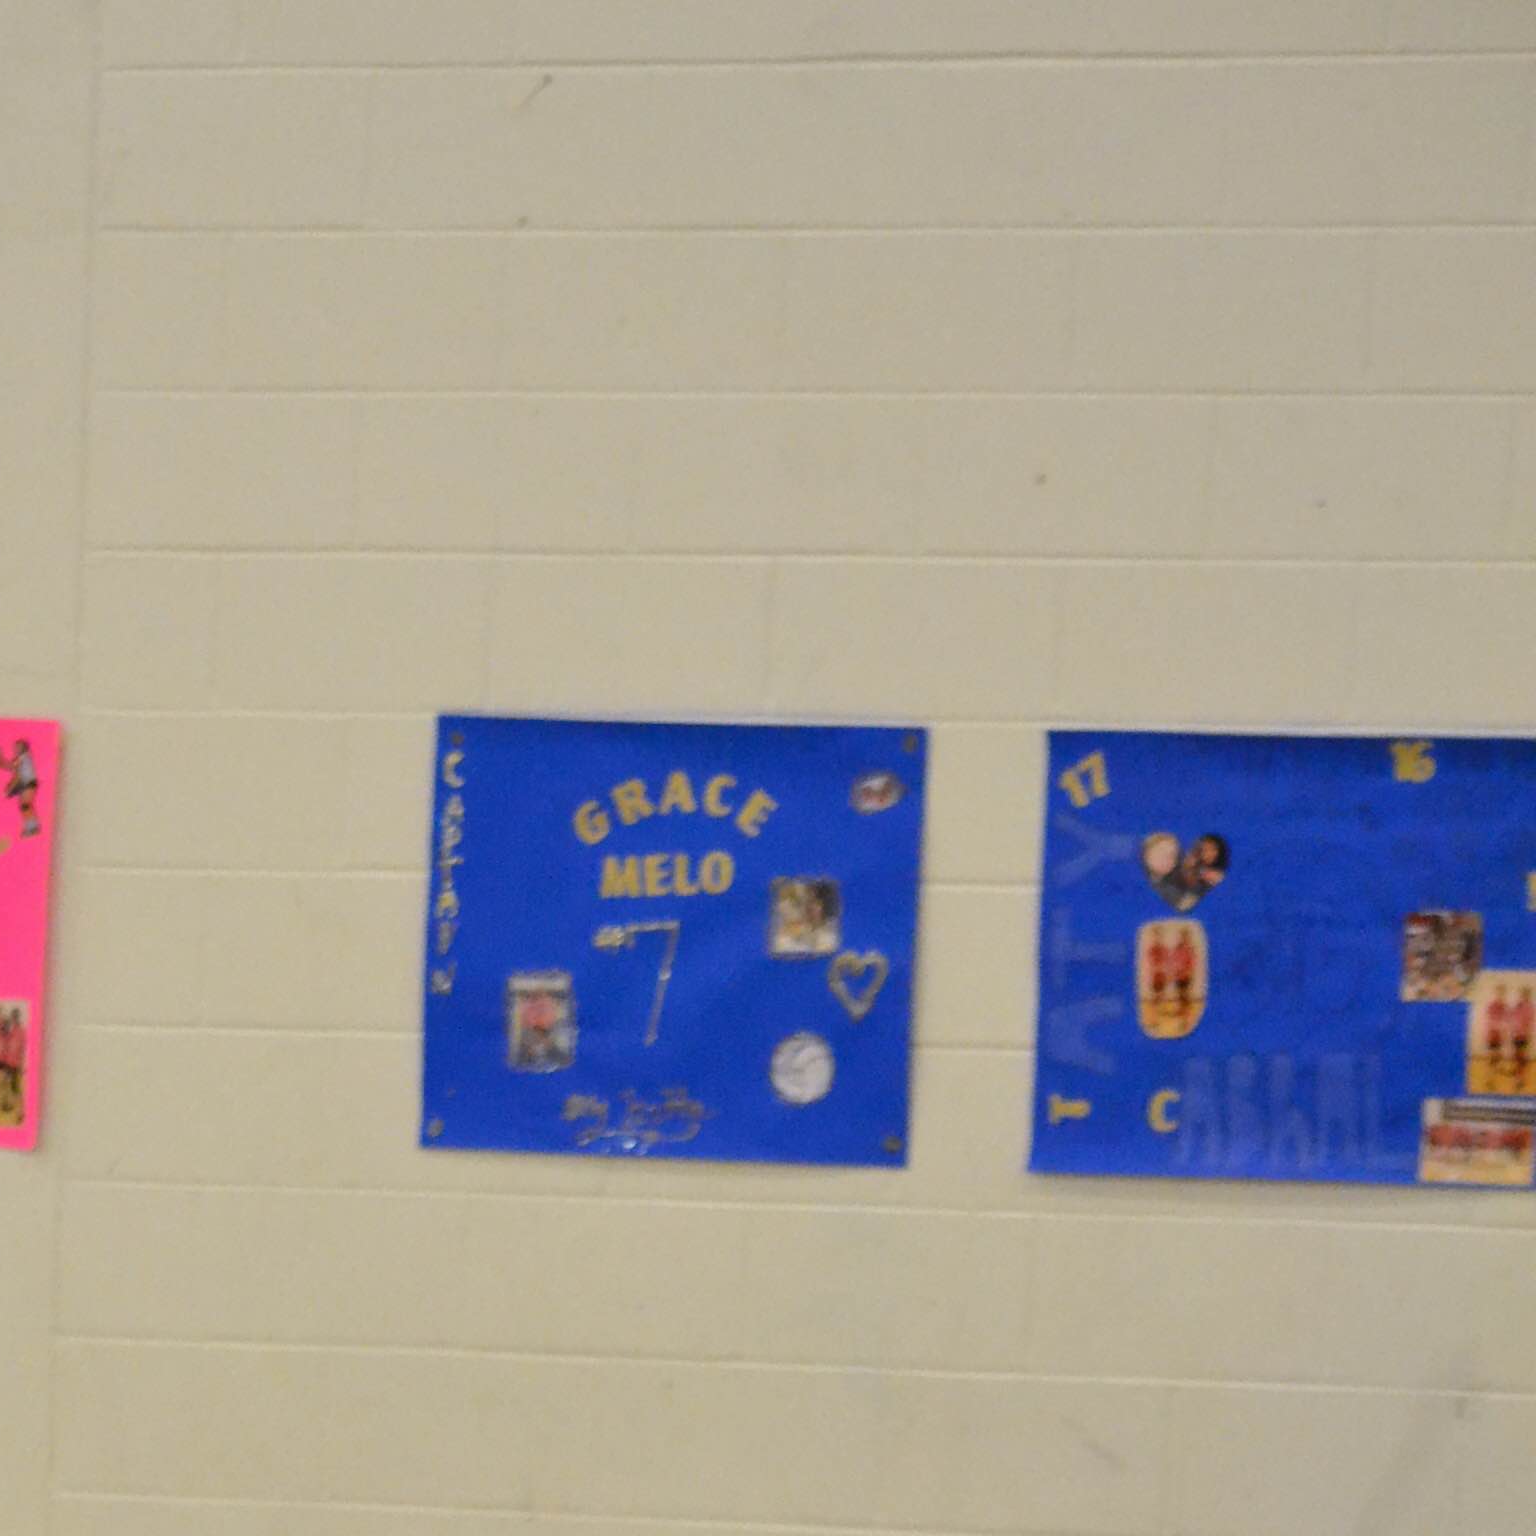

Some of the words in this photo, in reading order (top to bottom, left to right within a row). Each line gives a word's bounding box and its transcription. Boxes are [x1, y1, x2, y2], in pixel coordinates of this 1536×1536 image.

[572, 770, 781, 845] GRACE
[1057, 752, 1111, 807] 17
[599, 850, 736, 899] MELO
[593, 920, 681, 1047] 7
